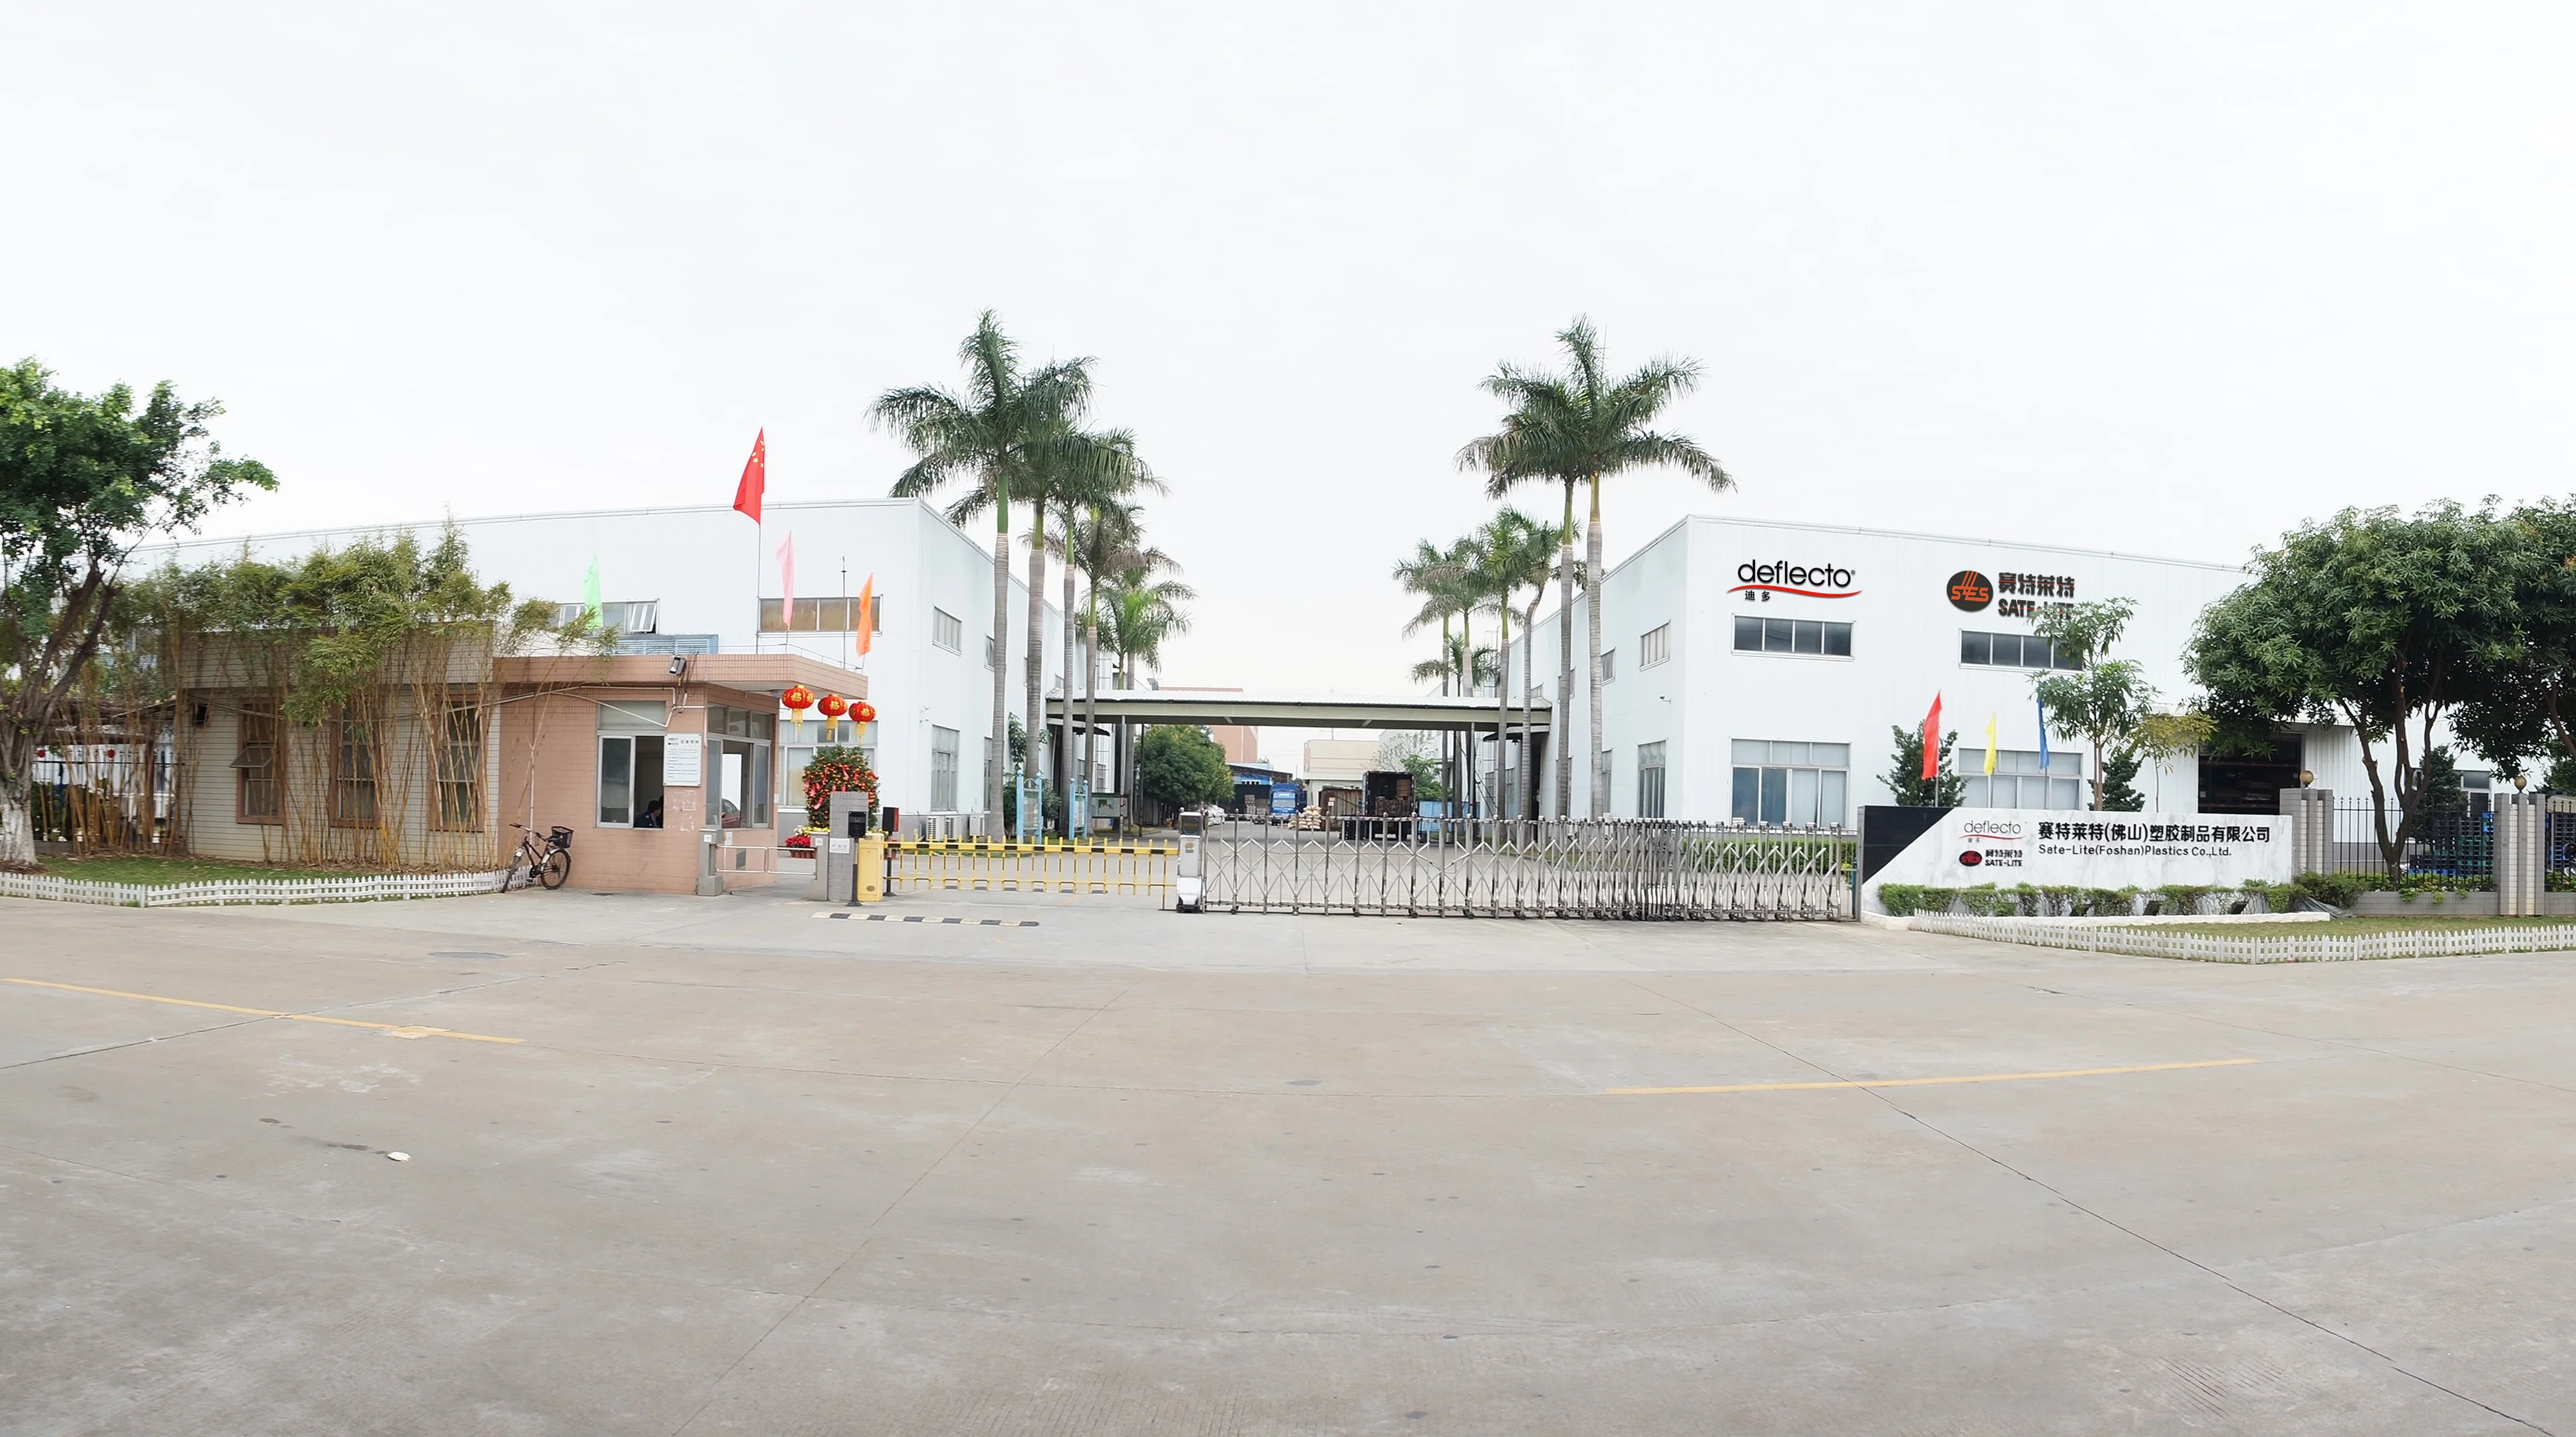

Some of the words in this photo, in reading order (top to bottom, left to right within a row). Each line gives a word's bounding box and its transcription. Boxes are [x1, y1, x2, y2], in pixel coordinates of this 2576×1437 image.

[1998, 571, 2075, 598] 赛特莱特
[1745, 590, 1771, 601] 迪多
[1963, 820, 2021, 834] deflecto
